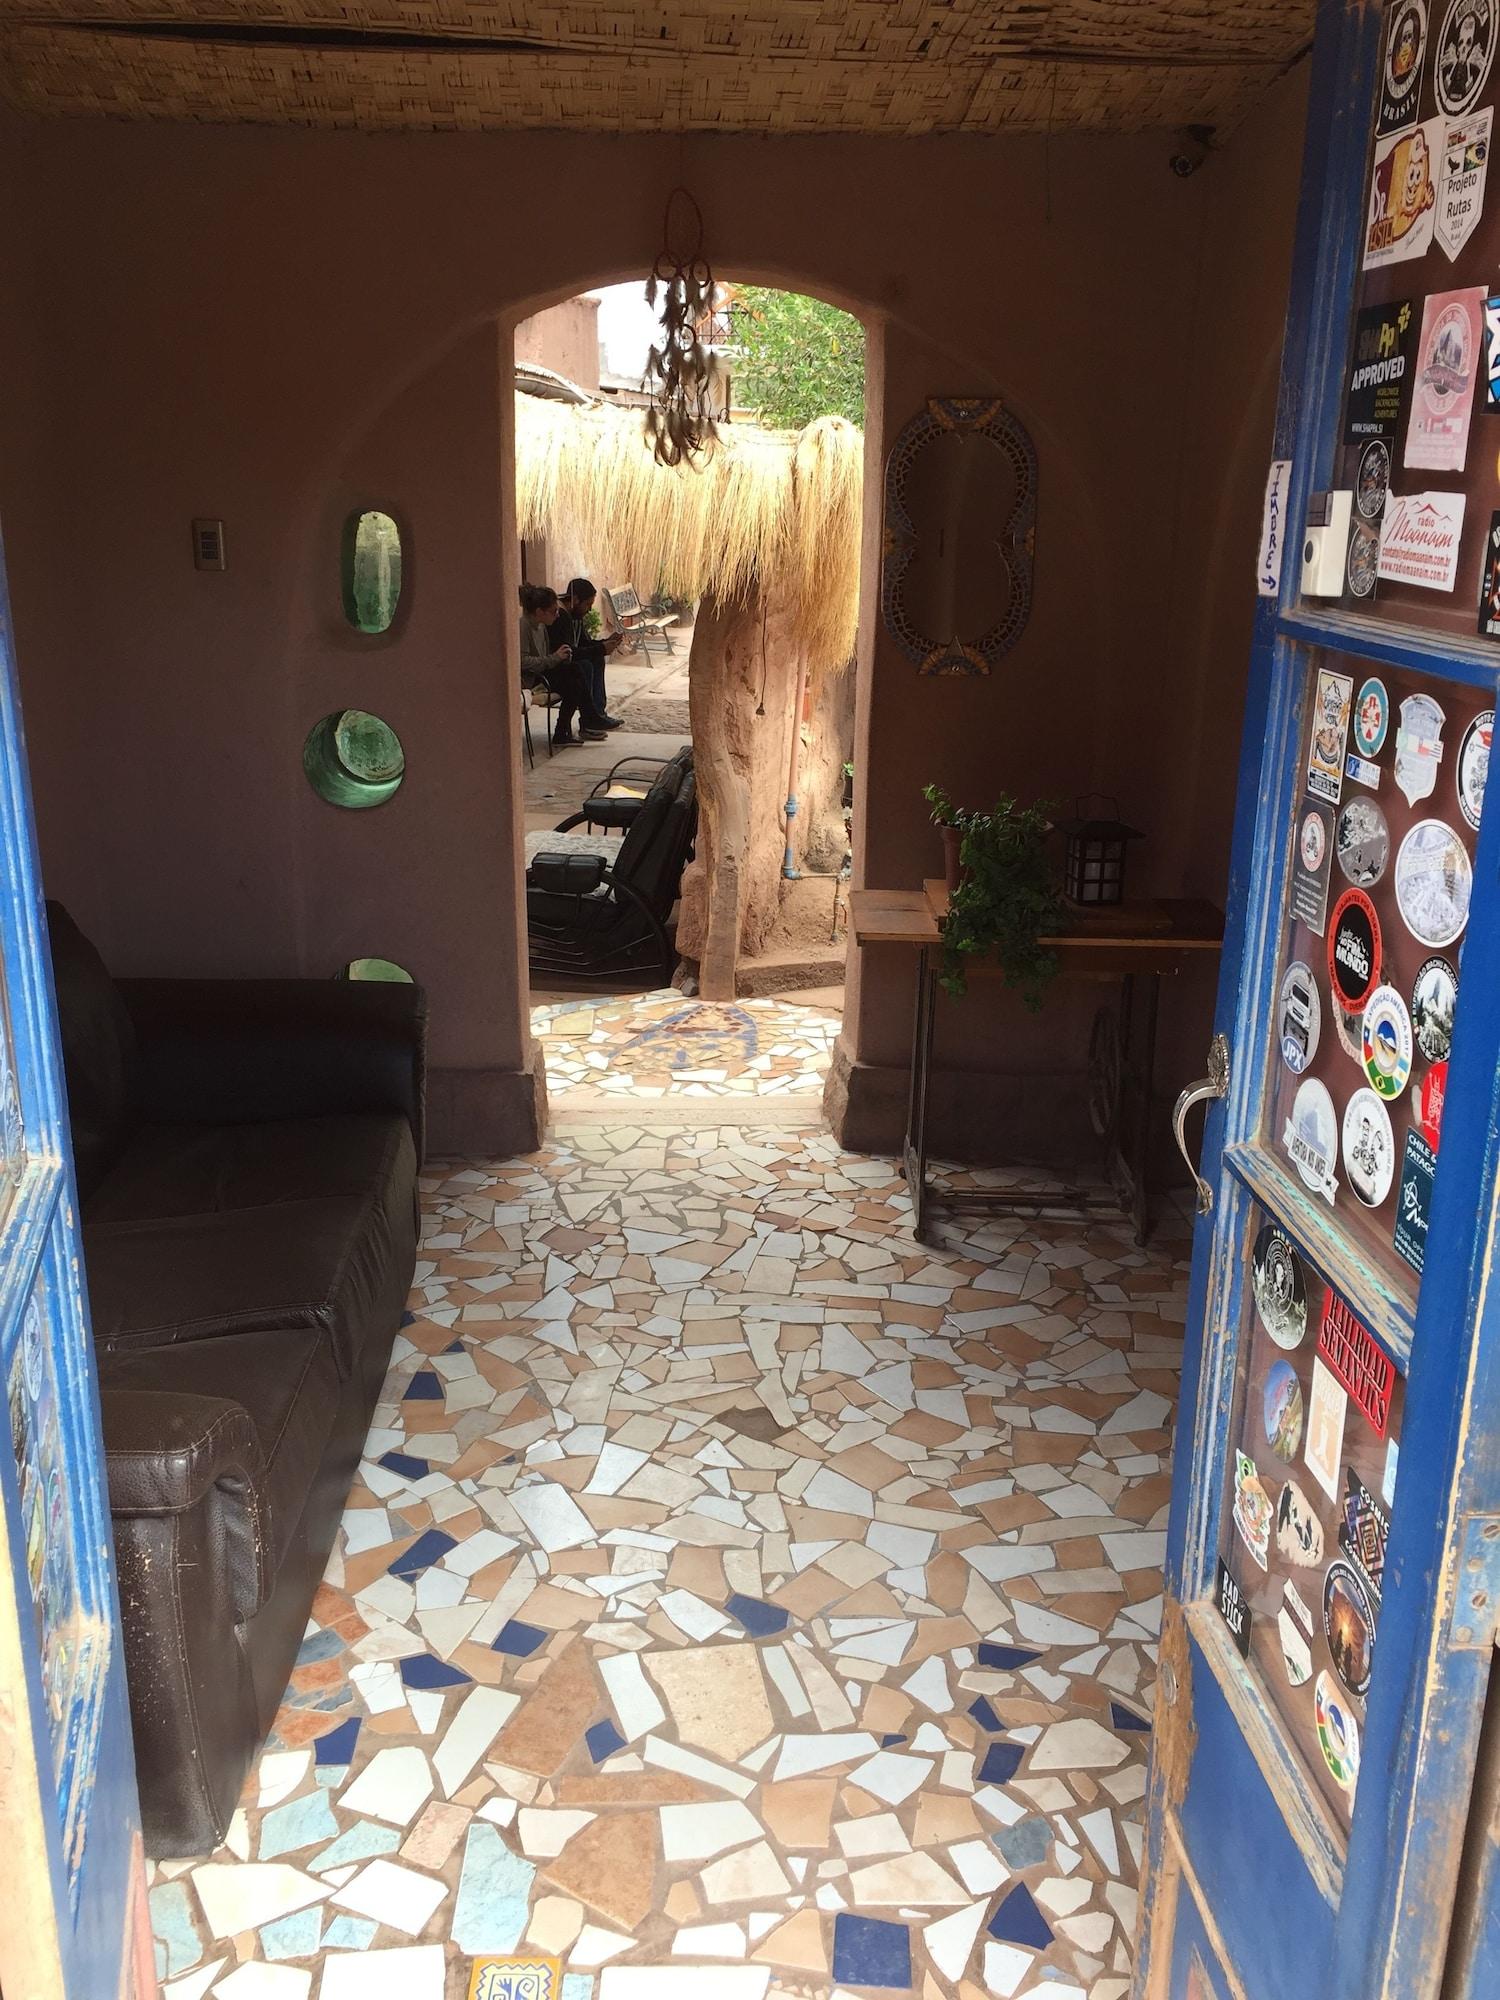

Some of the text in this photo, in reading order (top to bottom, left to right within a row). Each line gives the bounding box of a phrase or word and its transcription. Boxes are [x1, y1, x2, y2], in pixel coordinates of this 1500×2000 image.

[1384, 92, 1416, 121] BRASIL
[1447, 172, 1478, 195] Projeto
[1446, 198, 1472, 219] Rutas
[1351, 355, 1406, 391] APPROVED
[1335, 944, 1369, 976] MUNDO
[1283, 1040, 1303, 1071] JPX
[1408, 1134, 1437, 1164] CHILE &
[1359, 1485, 1390, 1535] COSMIC
[1222, 1570, 1239, 1605] RAD
[1221, 1592, 1244, 1634] STICK
